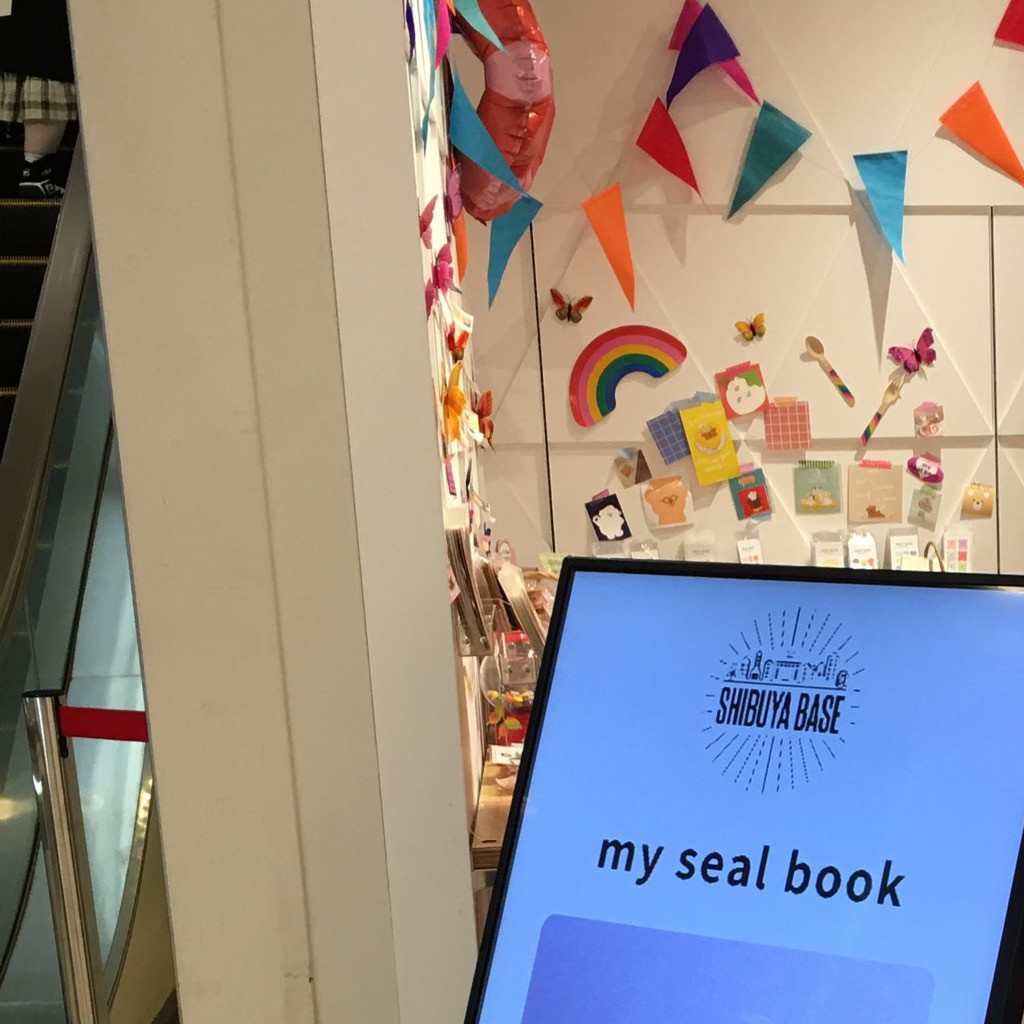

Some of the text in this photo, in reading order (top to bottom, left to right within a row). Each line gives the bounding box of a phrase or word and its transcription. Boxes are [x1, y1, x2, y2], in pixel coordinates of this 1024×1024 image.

[715, 686, 846, 735] SHIBUYA BASE
[597, 838, 905, 907] my seal book
